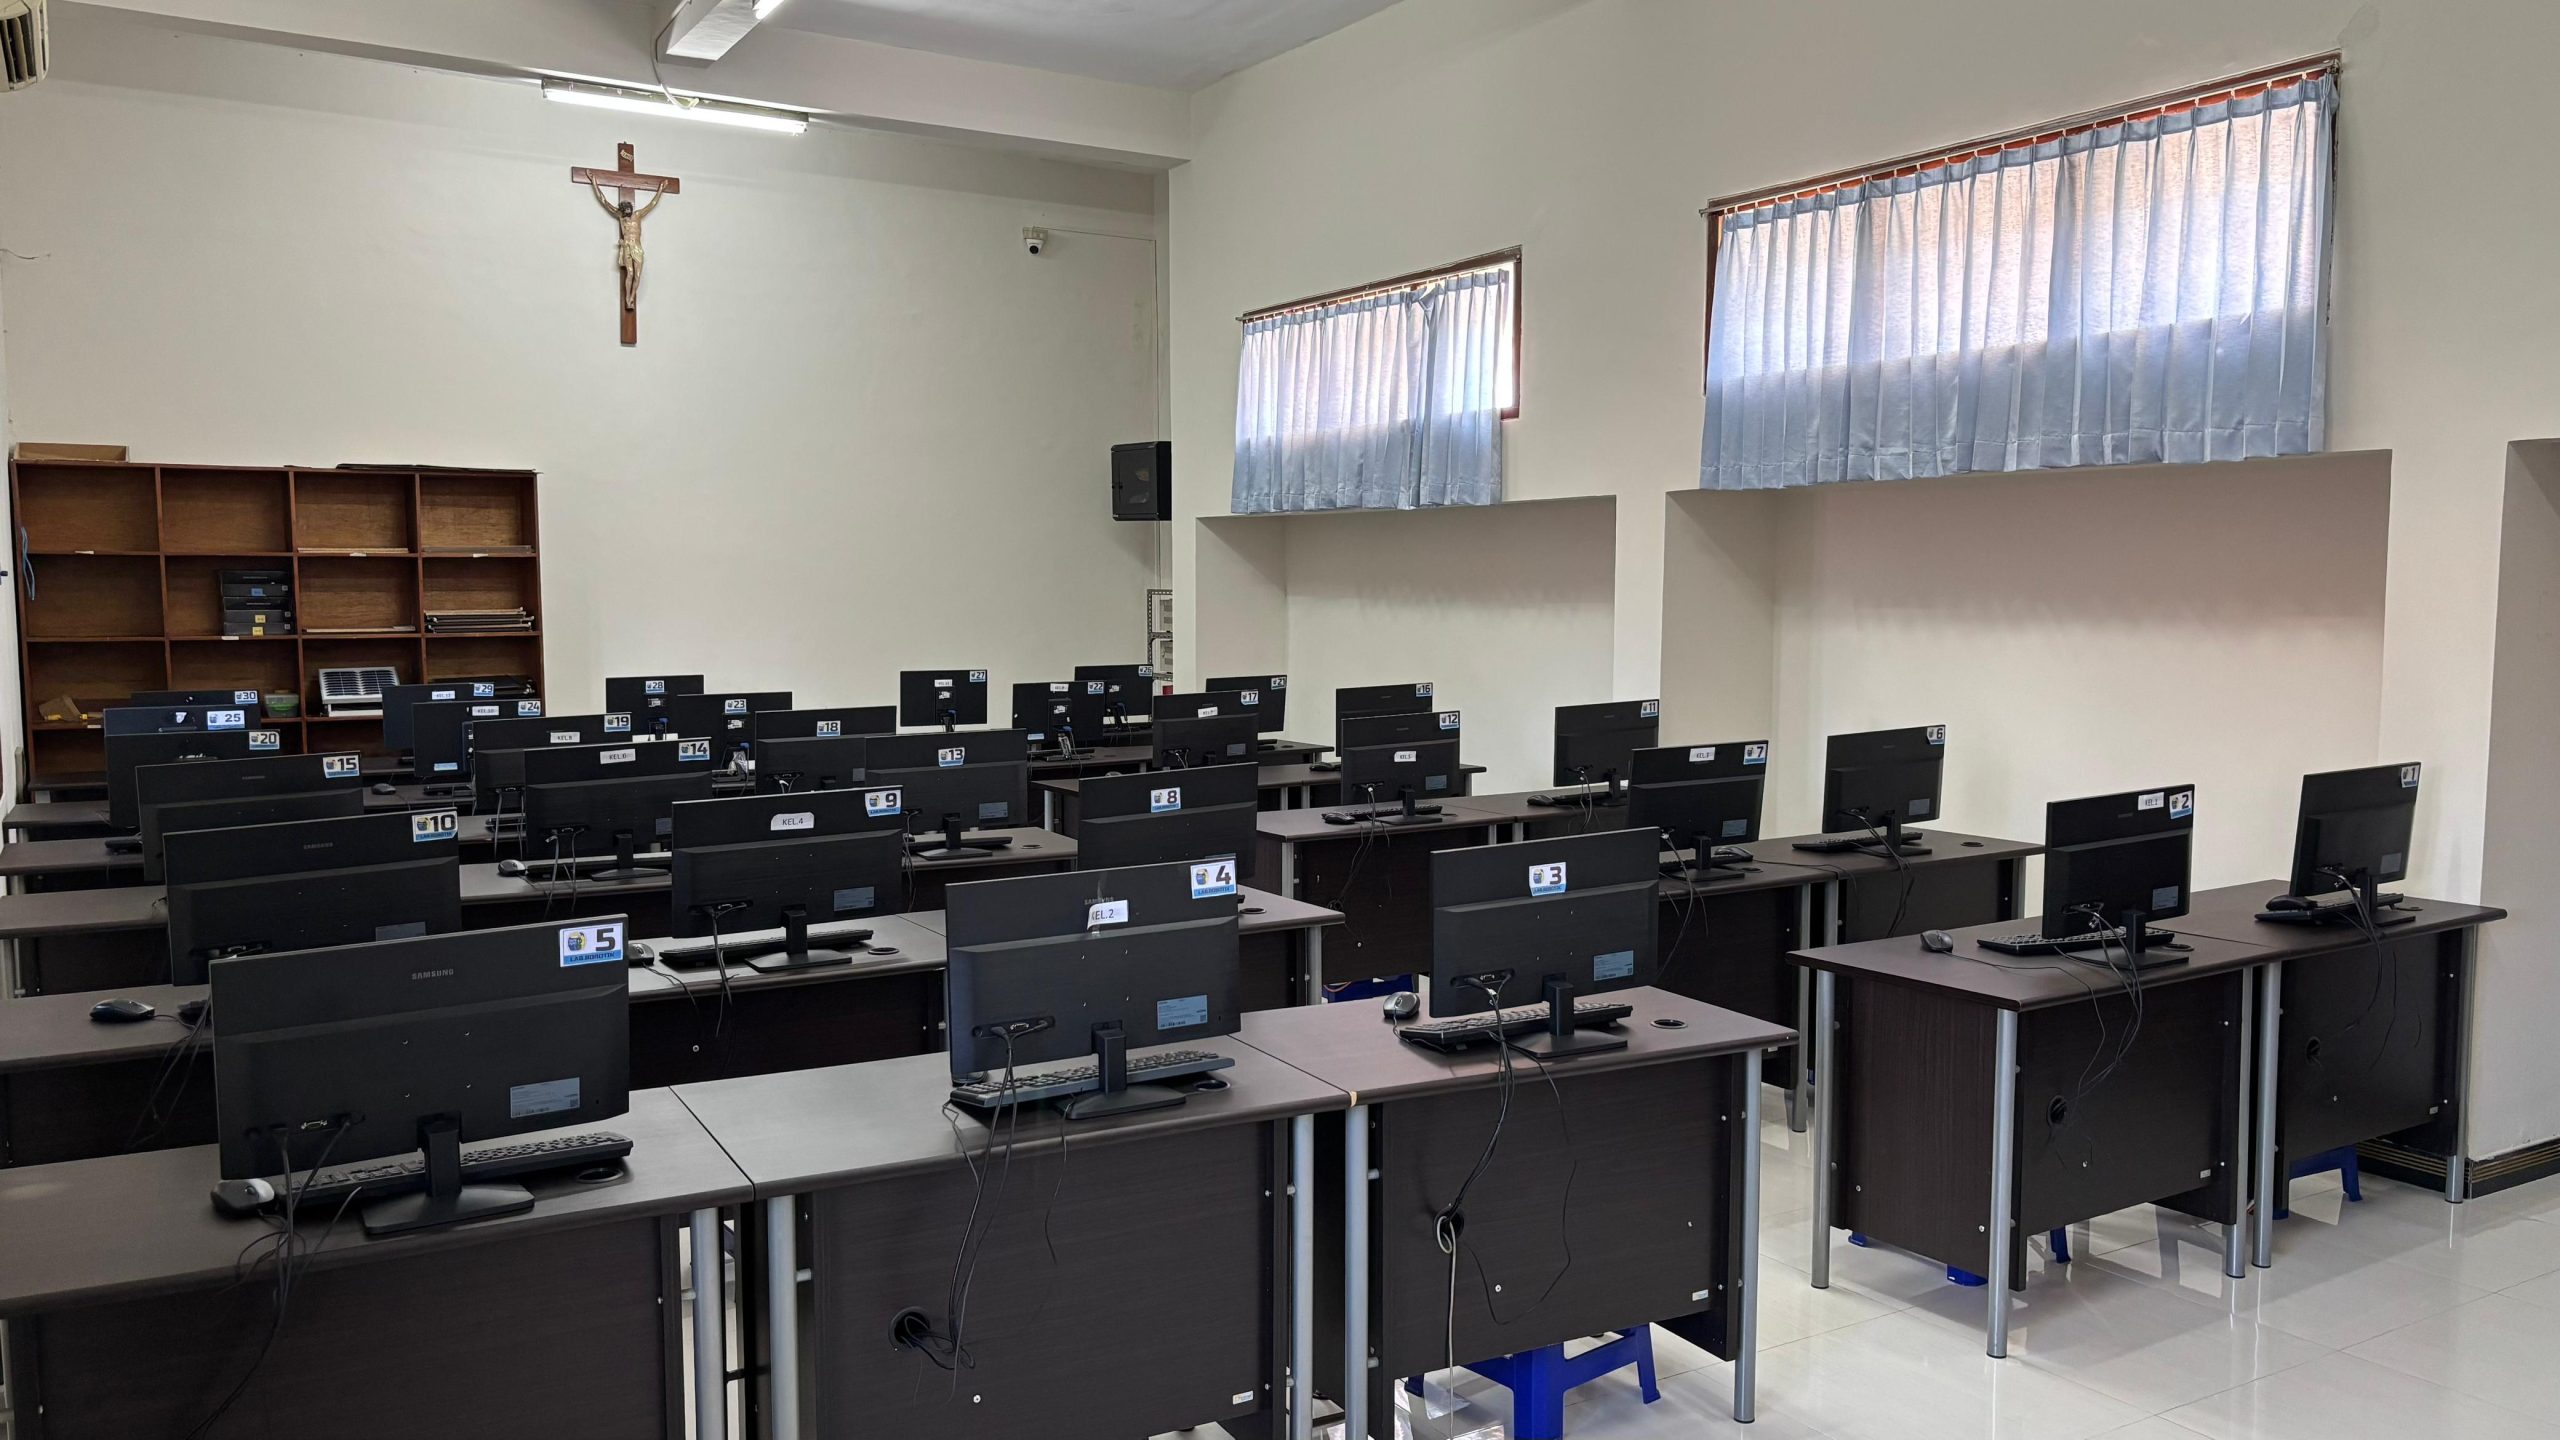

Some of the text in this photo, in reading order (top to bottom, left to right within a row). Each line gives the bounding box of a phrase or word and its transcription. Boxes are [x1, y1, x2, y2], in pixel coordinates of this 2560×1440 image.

[1422, 685, 1430, 693] 16
[242, 691, 256, 700] 30
[527, 702, 539, 711] 24
[1649, 703, 1655, 711] 11
[225, 714, 241, 722] 25
[615, 716, 629, 726] 19
[1447, 714, 1458, 724] 12
[824, 722, 838, 732] 18
[260, 733, 277, 745] 20
[1937, 728, 1943, 740] 6
[691, 742, 707, 755] 14
[948, 748, 963, 760] 13
[1757, 746, 1764, 757] 7
[338, 758, 357, 770] 15
[886, 793, 897, 808] 9
[1167, 790, 1177, 803] 8
[2182, 794, 2189, 809] 2
[430, 814, 456, 832] 10
[782, 817, 803, 826] KEL.4
[1216, 865, 1231, 884] 4
[1550, 866, 1561, 884] 3
[596, 928, 615, 951] 5
[412, 968, 454, 980] SAMSUNG
